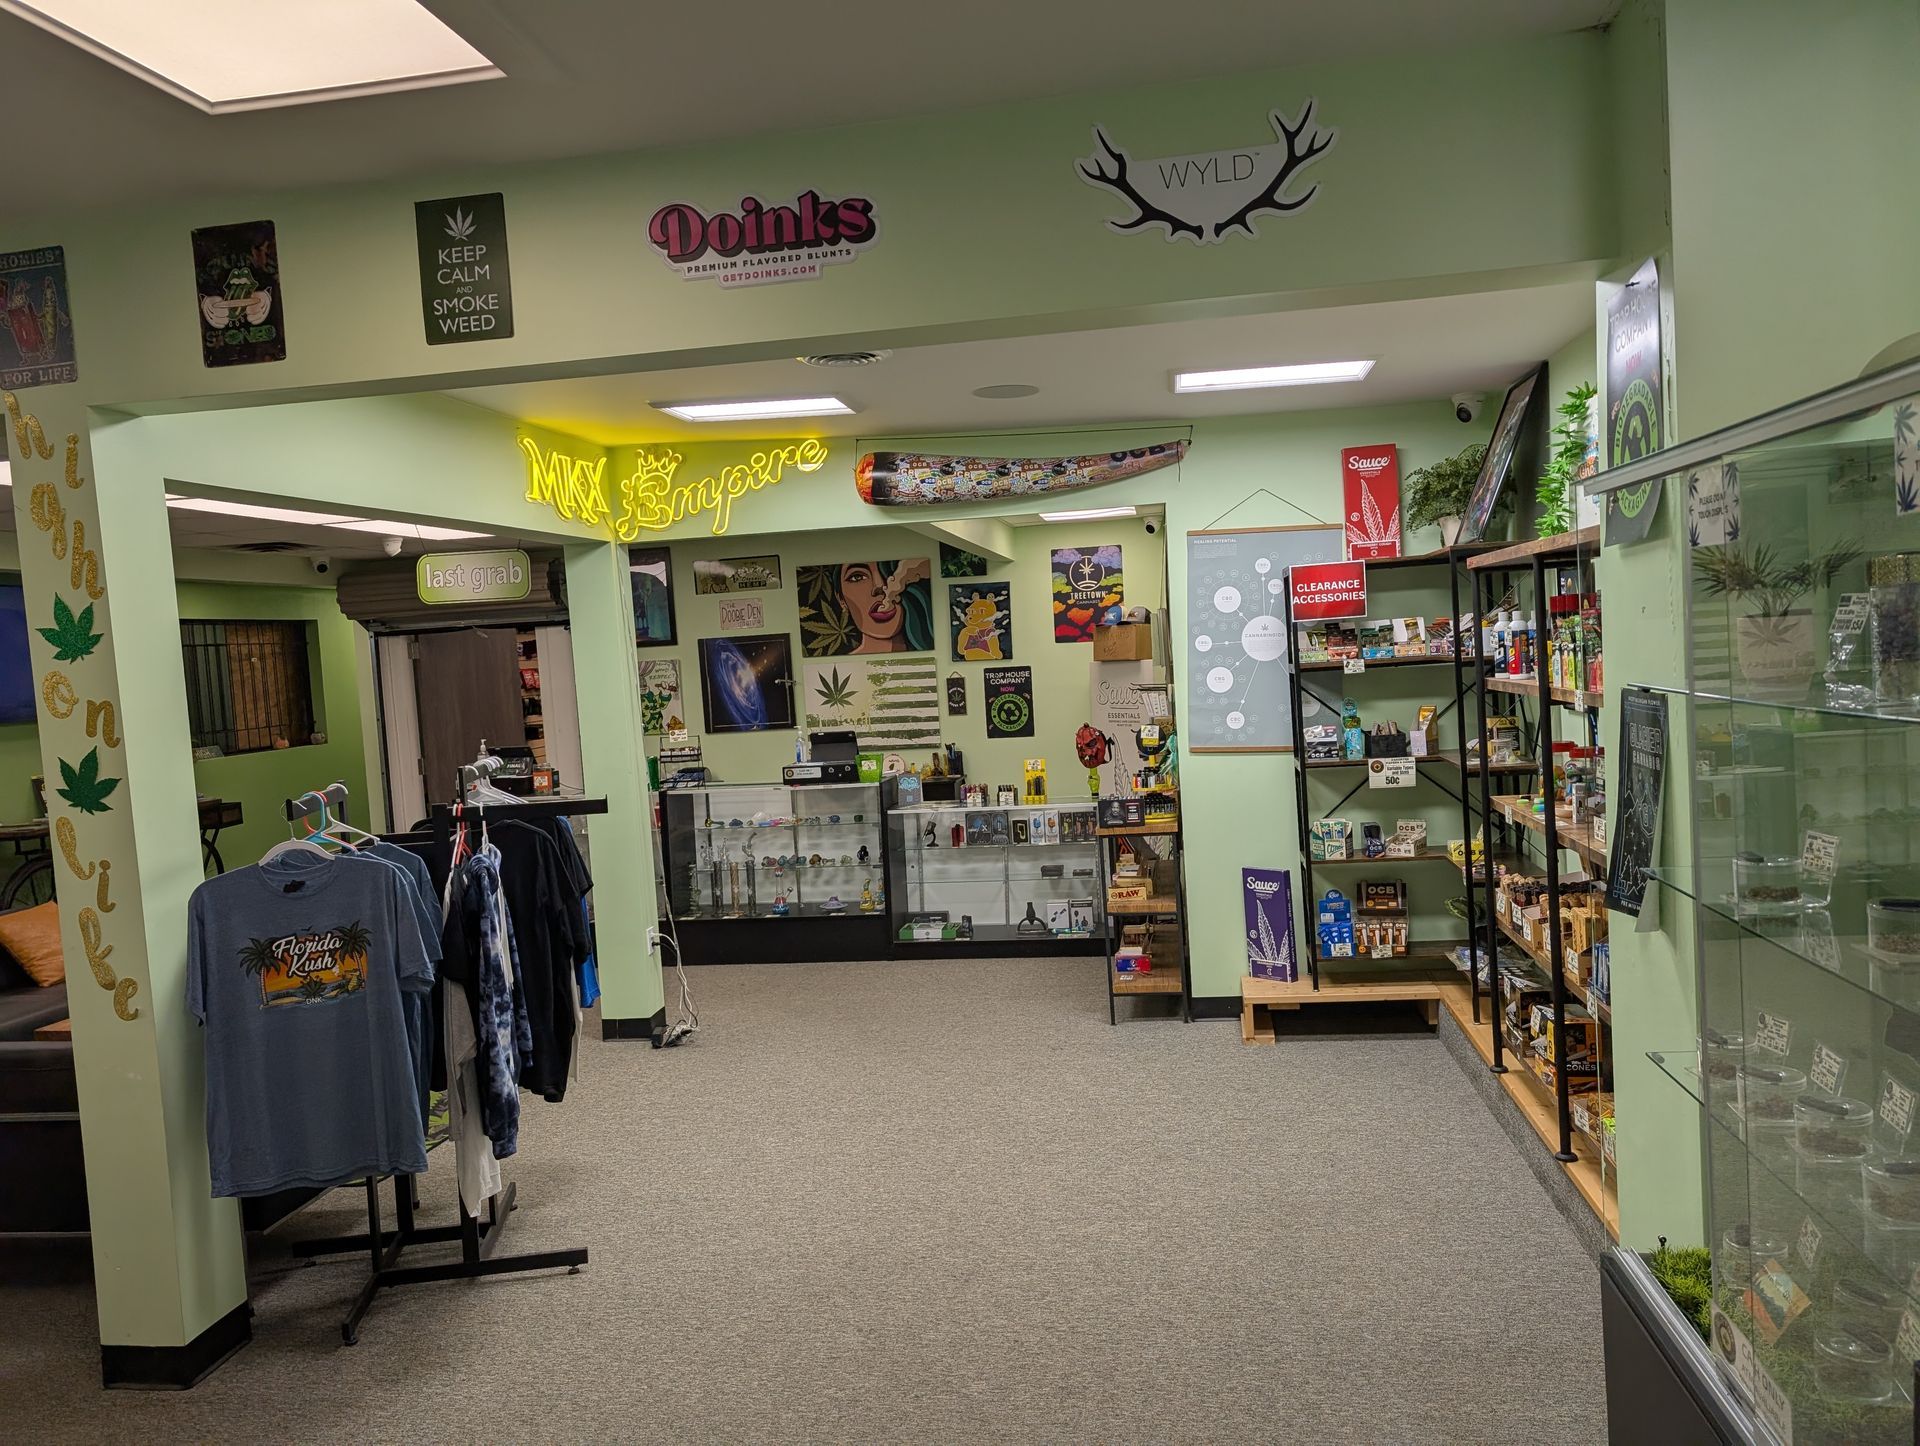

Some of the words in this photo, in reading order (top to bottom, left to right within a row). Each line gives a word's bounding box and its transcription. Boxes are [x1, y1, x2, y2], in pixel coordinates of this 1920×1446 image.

[648, 189, 876, 263] Doinks
[437, 244, 487, 265] KEEP
[687, 260, 737, 274] PREMIUM
[742, 253, 802, 268] FLAVORED
[807, 248, 852, 260] BLUNTS
[437, 264, 491, 285] CALM
[722, 264, 817, 283] GETDOINKS.COM
[455, 285, 473, 294] AND
[433, 293, 499, 315] SMOKE
[439, 314, 496, 335] WEED
[1625, 350, 1642, 374] NOW
[4, 371, 32, 386] FOR
[38, 366, 72, 382] LIFE
[1615, 381, 1657, 448] BIODEGRADABLE
[1348, 455, 1391, 470] Sauce
[616, 438, 828, 541] Empire
[424, 562, 466, 589] last
[470, 558, 524, 593] grab
[1070, 591, 1105, 600] TREETOWN
[1296, 579, 1361, 593] CLEARANCE
[1293, 591, 1366, 605] ACCESSORIES
[747, 603, 763, 619] DEN
[990, 677, 1026, 685] COMPANY
[1005, 670, 1030, 678] HOUSE
[42, 670, 121, 749] on
[1246, 876, 1279, 891] Sauce
[1367, 885, 1395, 894] OCB
[1118, 889, 1140, 899] RAW
[272, 933, 344, 959] Florida
[289, 951, 336, 977] Kush
